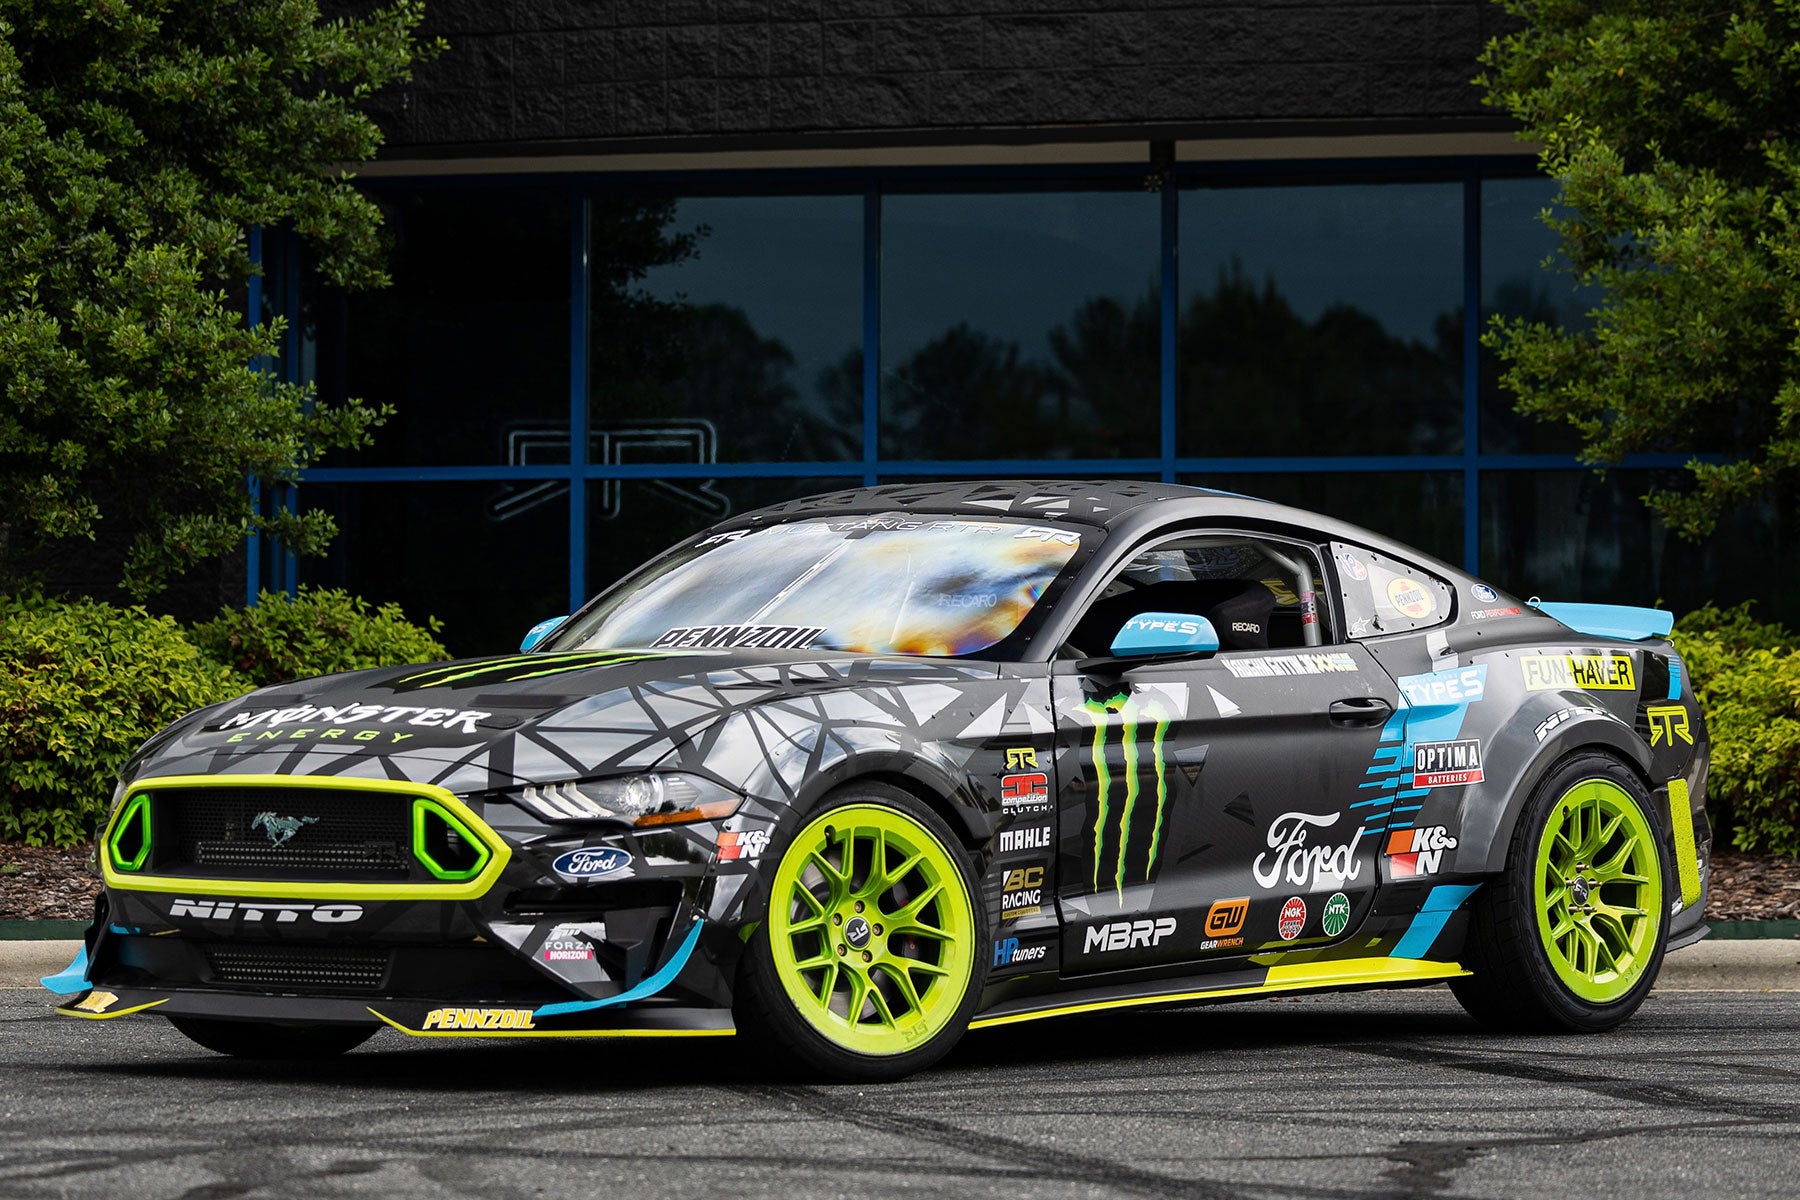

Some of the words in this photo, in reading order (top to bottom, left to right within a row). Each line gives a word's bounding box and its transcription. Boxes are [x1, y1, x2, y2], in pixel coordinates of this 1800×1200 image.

[760, 521, 922, 536] MUSTANG
[928, 522, 1001, 535] RTR
[938, 593, 998, 607] RECARO
[1232, 622, 1261, 634] RECARO
[649, 625, 828, 650] PENNZOIL
[226, 728, 416, 744] ENERGY
[1417, 745, 1479, 771] OPTIMA
[1428, 773, 1467, 784] BATTERIES
[1003, 805, 1048, 815] CLUTCH
[1000, 827, 1050, 852] MAHLE
[1253, 812, 1365, 888] Ford
[568, 851, 616, 874] Ford
[1003, 866, 1044, 892] BC
[1002, 889, 1041, 909] RACING
[169, 898, 364, 923] NITTO
[1284, 907, 1302, 918] NGK
[1328, 904, 1345, 915] NTK
[1083, 917, 1177, 954] MBRP
[1200, 937, 1244, 950] GEARWRENCH
[545, 941, 594, 950] FORZA
[550, 951, 588, 960] HORIZON
[422, 1008, 536, 1030] PENNZOIL
